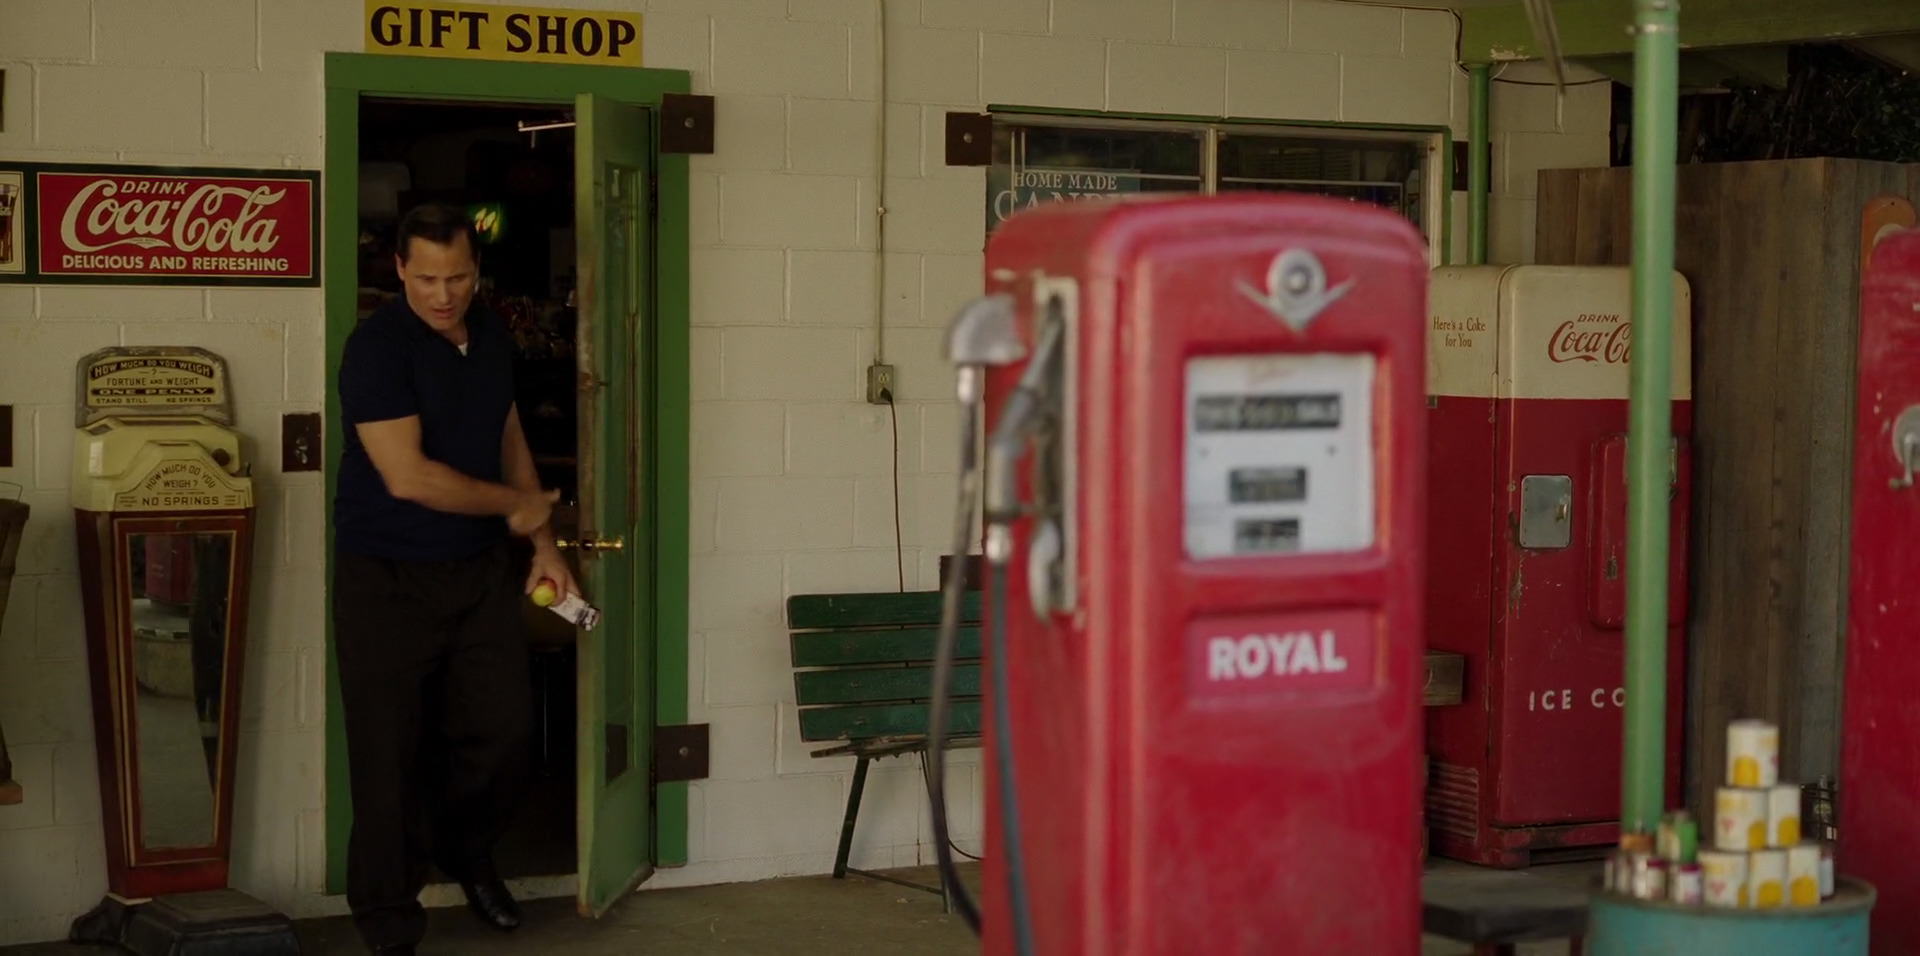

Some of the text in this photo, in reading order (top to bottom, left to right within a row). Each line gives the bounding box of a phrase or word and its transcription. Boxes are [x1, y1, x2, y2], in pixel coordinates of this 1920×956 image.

[370, 6, 636, 57] GIFT SHOP
[120, 180, 189, 195] DRINK
[1014, 172, 1118, 190] HOME MADE
[60, 179, 287, 253] Coca-Cola
[62, 254, 289, 271] DELICIOUS AND REFRESHING
[1433, 316, 1487, 332] Here's a Coke
[1577, 314, 1619, 322] DRINK
[1445, 332, 1473, 348] for You
[1548, 320, 1632, 364] Coca-Co
[94, 365, 117, 377] HOW
[120, 359, 145, 369] MUCH
[160, 360, 177, 368] YOU
[178, 360, 211, 377] WEIGH
[106, 377, 147, 386] FORTUNE
[166, 377, 200, 386] WEIGHT
[145, 464, 216, 491] HOW MUCH DO YOU
[163, 479, 191, 488] WEIGH
[142, 497, 159, 506] NO
[164, 496, 219, 506] SPRINGS
[1208, 629, 1348, 681] ROYAL
[1529, 688, 1626, 711] ICE CO
